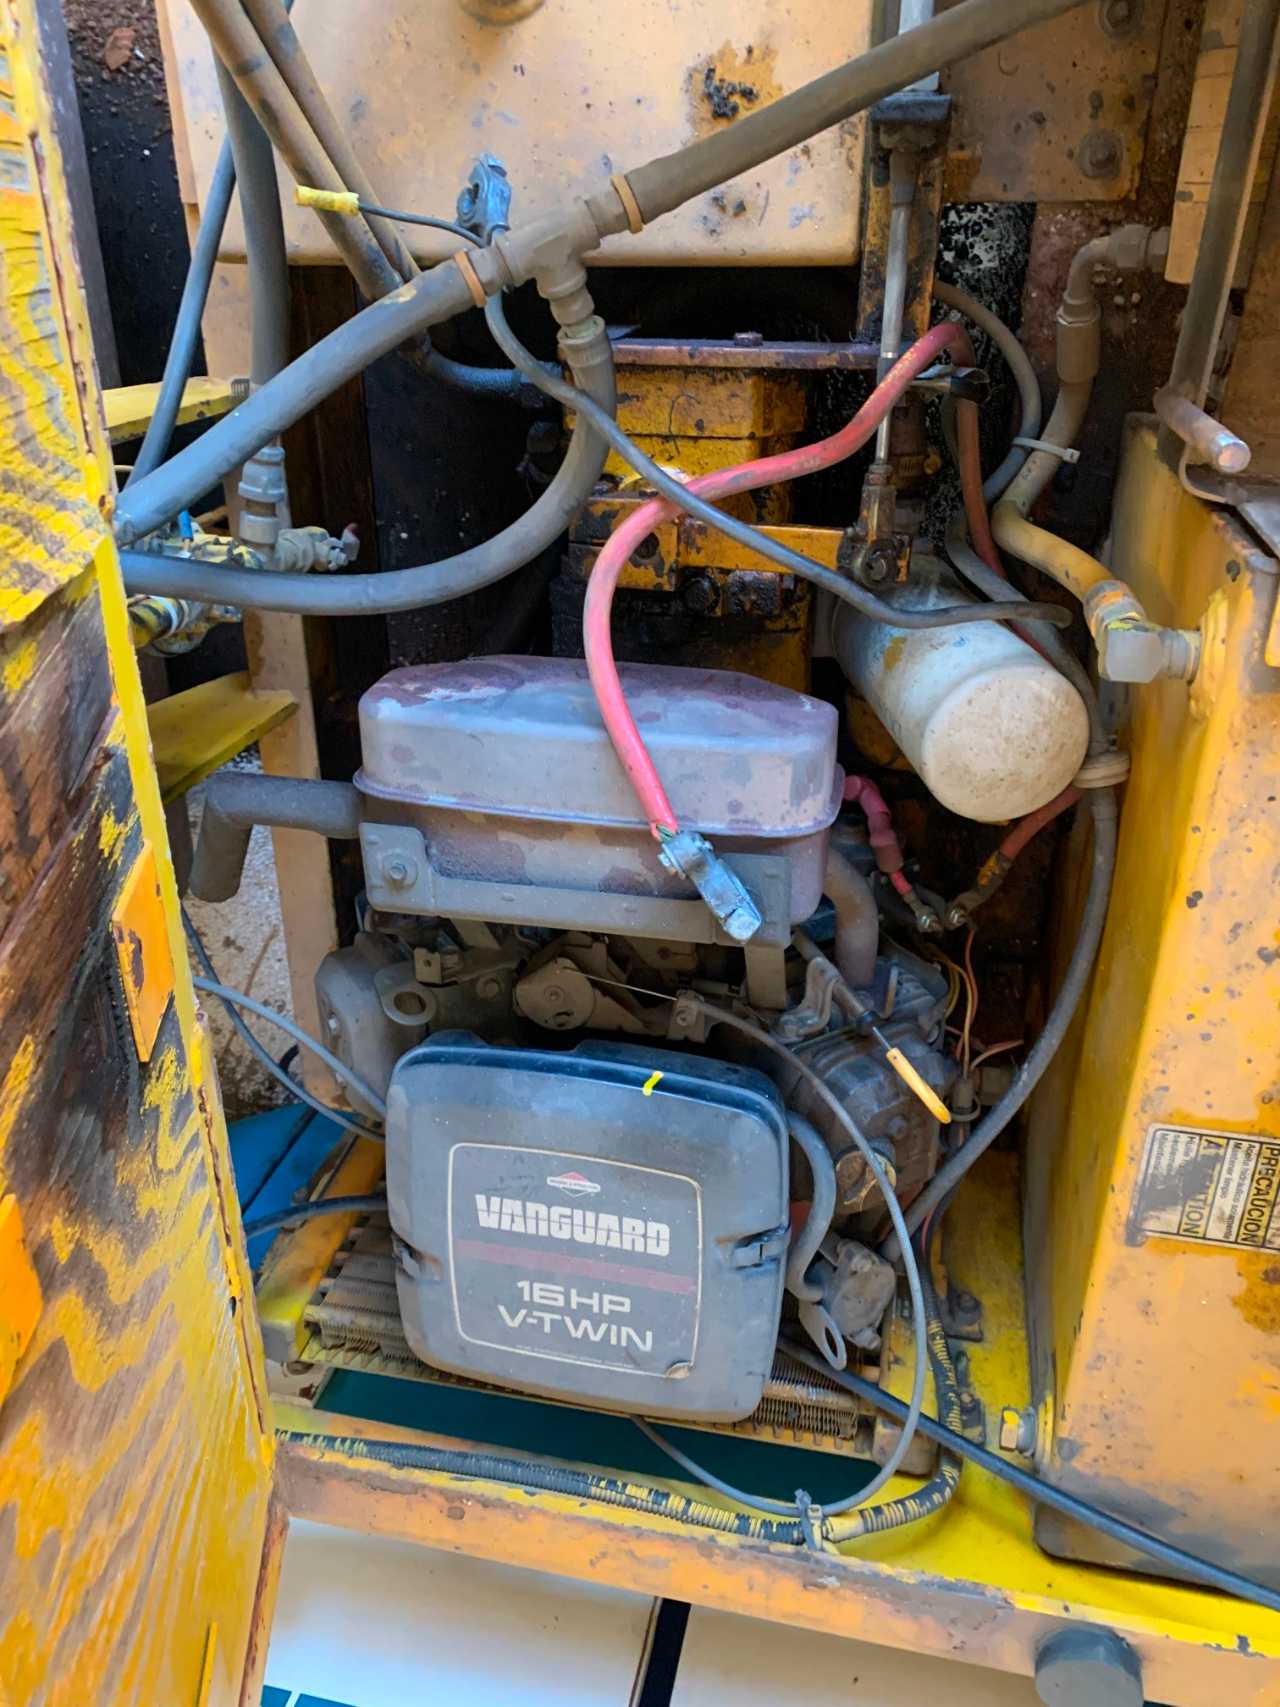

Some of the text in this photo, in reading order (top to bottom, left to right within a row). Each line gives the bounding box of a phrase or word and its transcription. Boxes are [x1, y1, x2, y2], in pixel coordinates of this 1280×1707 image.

[474, 1194, 670, 1257] VANGUARD
[1241, 1146, 1280, 1242] PRECAUCION
[497, 1304, 653, 1352] V-TWIN
